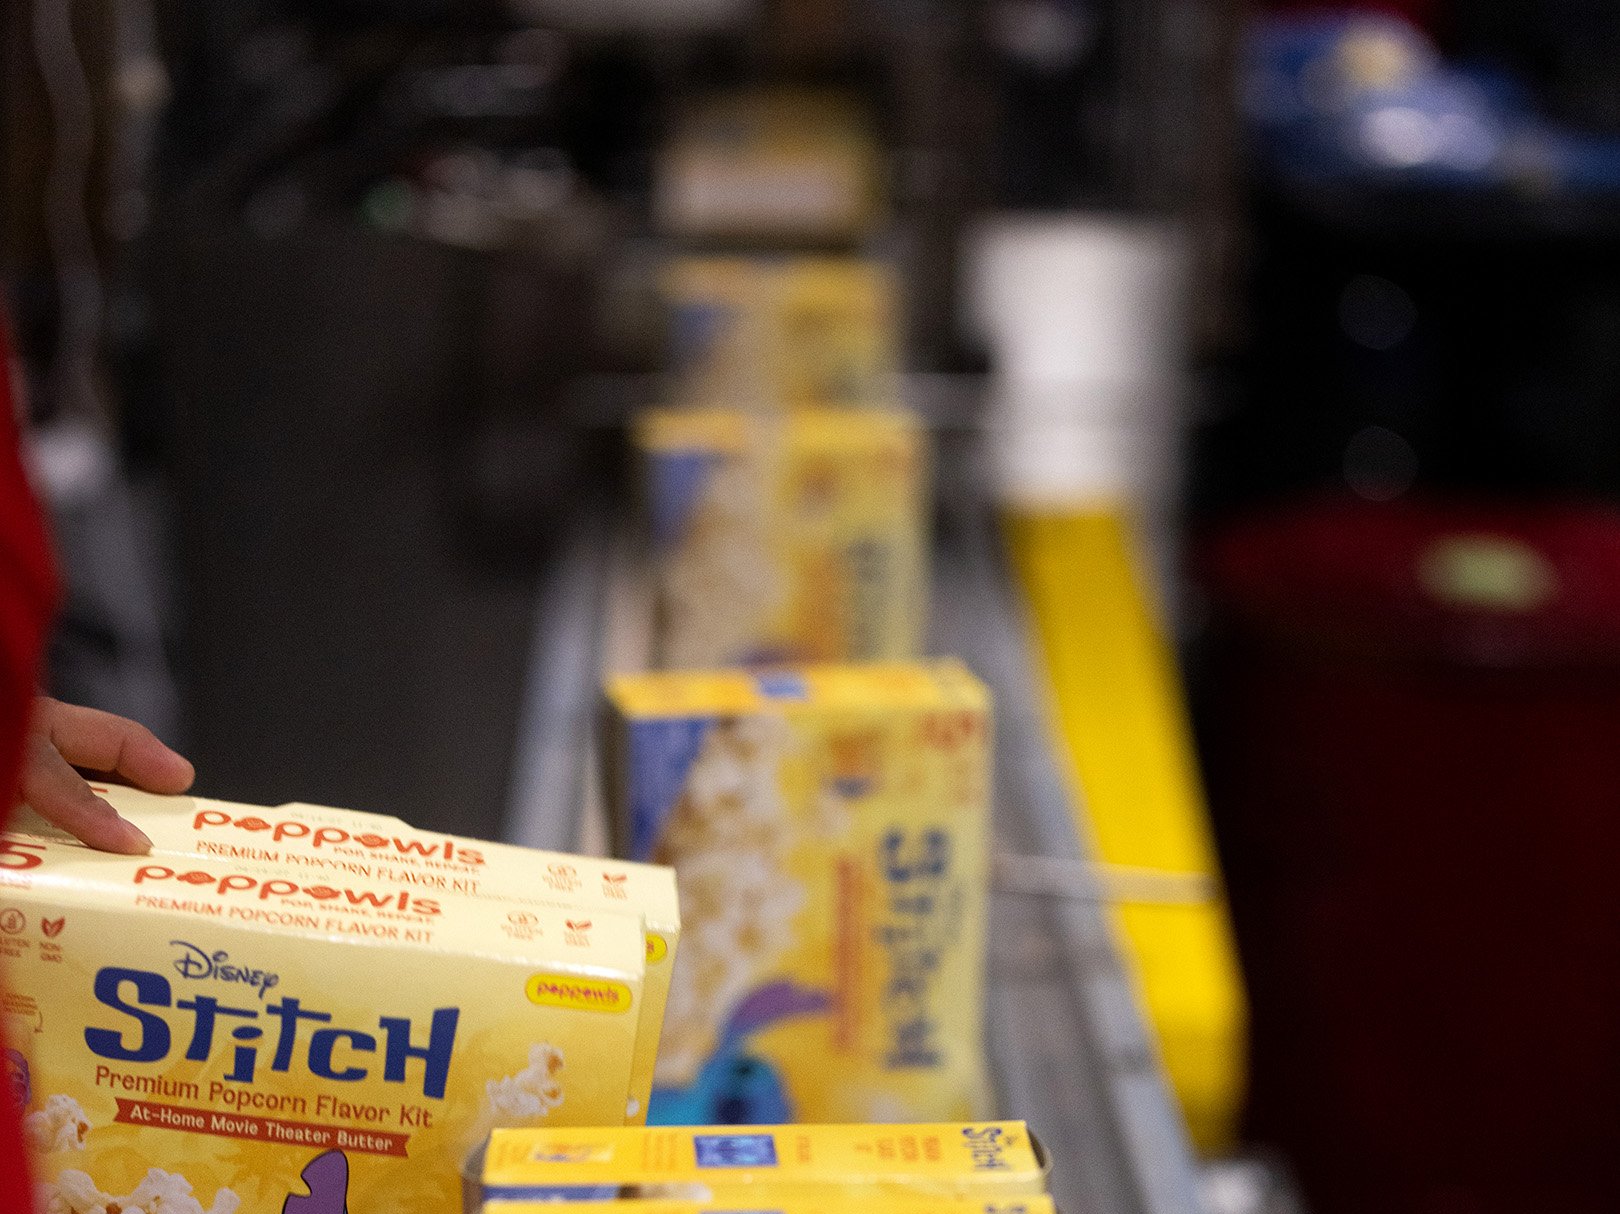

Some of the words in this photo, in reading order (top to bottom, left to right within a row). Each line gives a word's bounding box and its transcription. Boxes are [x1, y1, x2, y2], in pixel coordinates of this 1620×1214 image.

[197, 841, 279, 864] PREMIUM
[376, 863, 447, 890] FLAVOR
[451, 876, 481, 895] KIT
[136, 894, 223, 917] PREMIUM
[229, 901, 319, 930] POPCORN
[325, 917, 398, 940] FLAVOR
[404, 926, 434, 944] KIT
[95, 1065, 200, 1100] Premium
[209, 1081, 308, 1115] Popcorn
[315, 1093, 391, 1124] Flavor
[399, 1104, 434, 1130] Kit
[129, 1104, 206, 1130] At-Home
[211, 1115, 260, 1137] Movie
[265, 1121, 331, 1146] Theater
[337, 1130, 394, 1152] Butter
